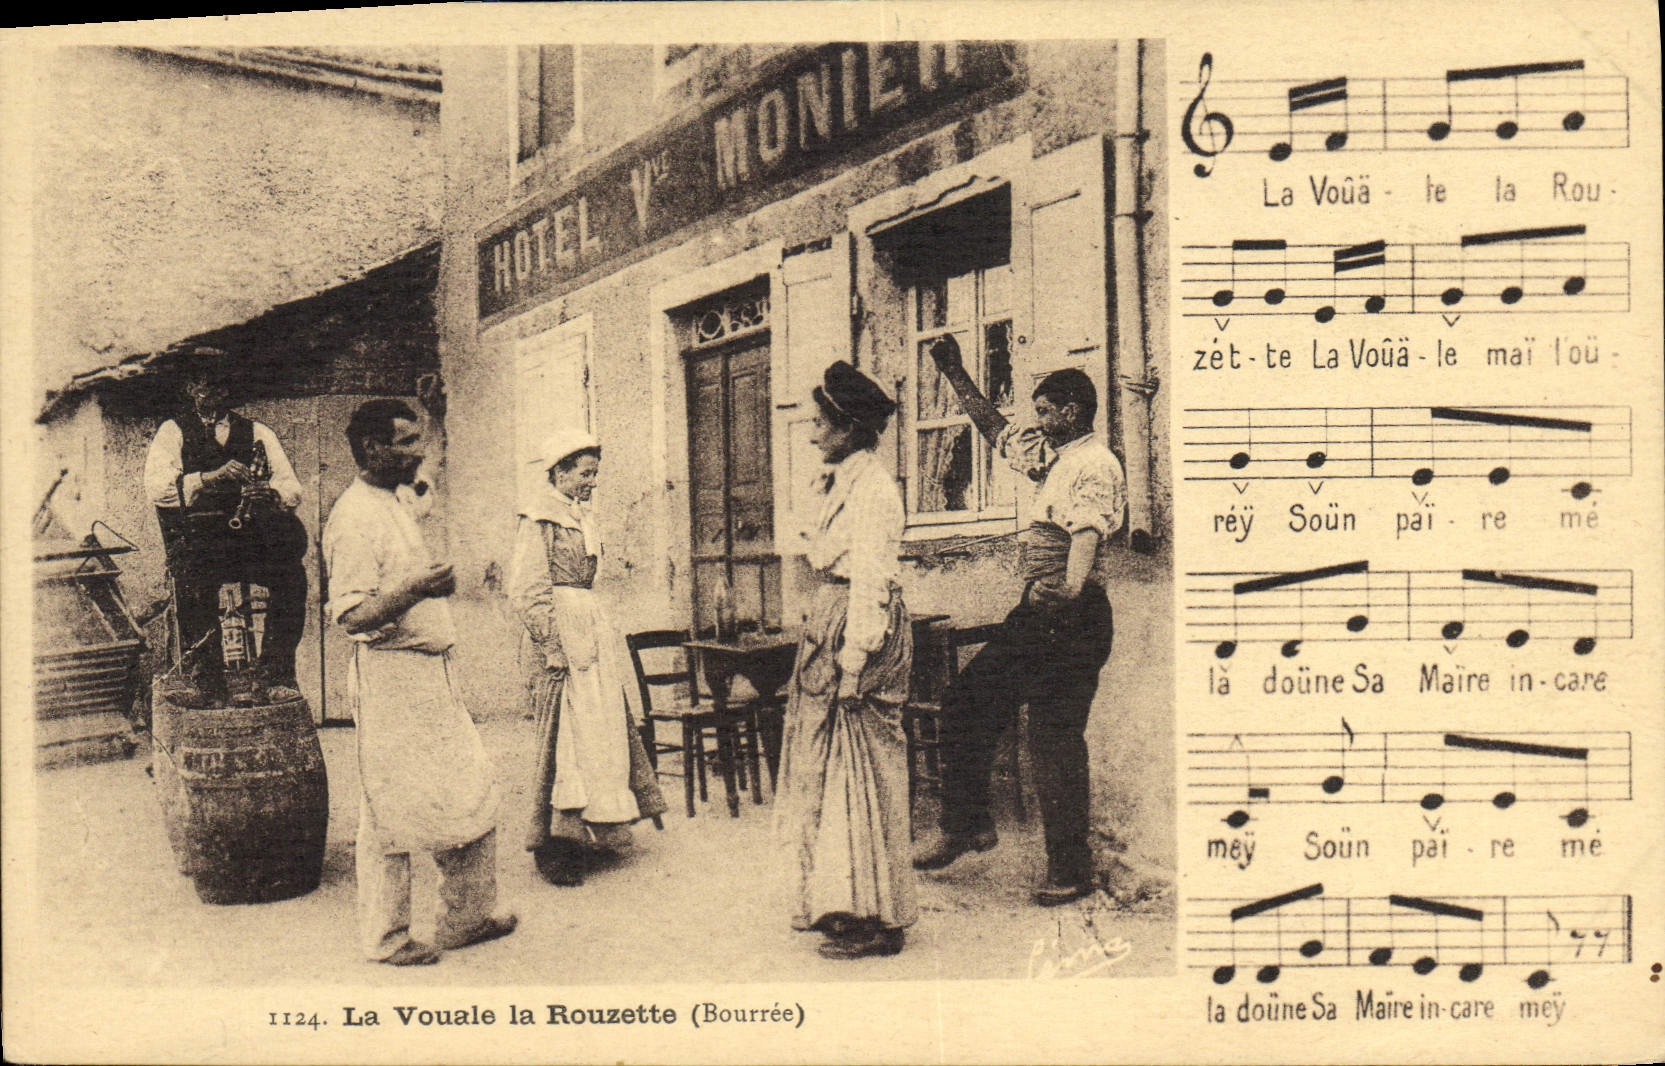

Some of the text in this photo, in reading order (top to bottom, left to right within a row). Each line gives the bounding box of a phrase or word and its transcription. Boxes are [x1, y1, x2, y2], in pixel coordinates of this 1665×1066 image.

[1263, 177, 1294, 208] La
[1495, 175, 1517, 203] la
[494, 196, 601, 294] HOTEL
[1312, 338, 1340, 370] La
[1481, 510, 1508, 531] re
[1351, 662, 1385, 694] Sa
[1490, 837, 1516, 858] re
[1311, 990, 1339, 1021] Sa
